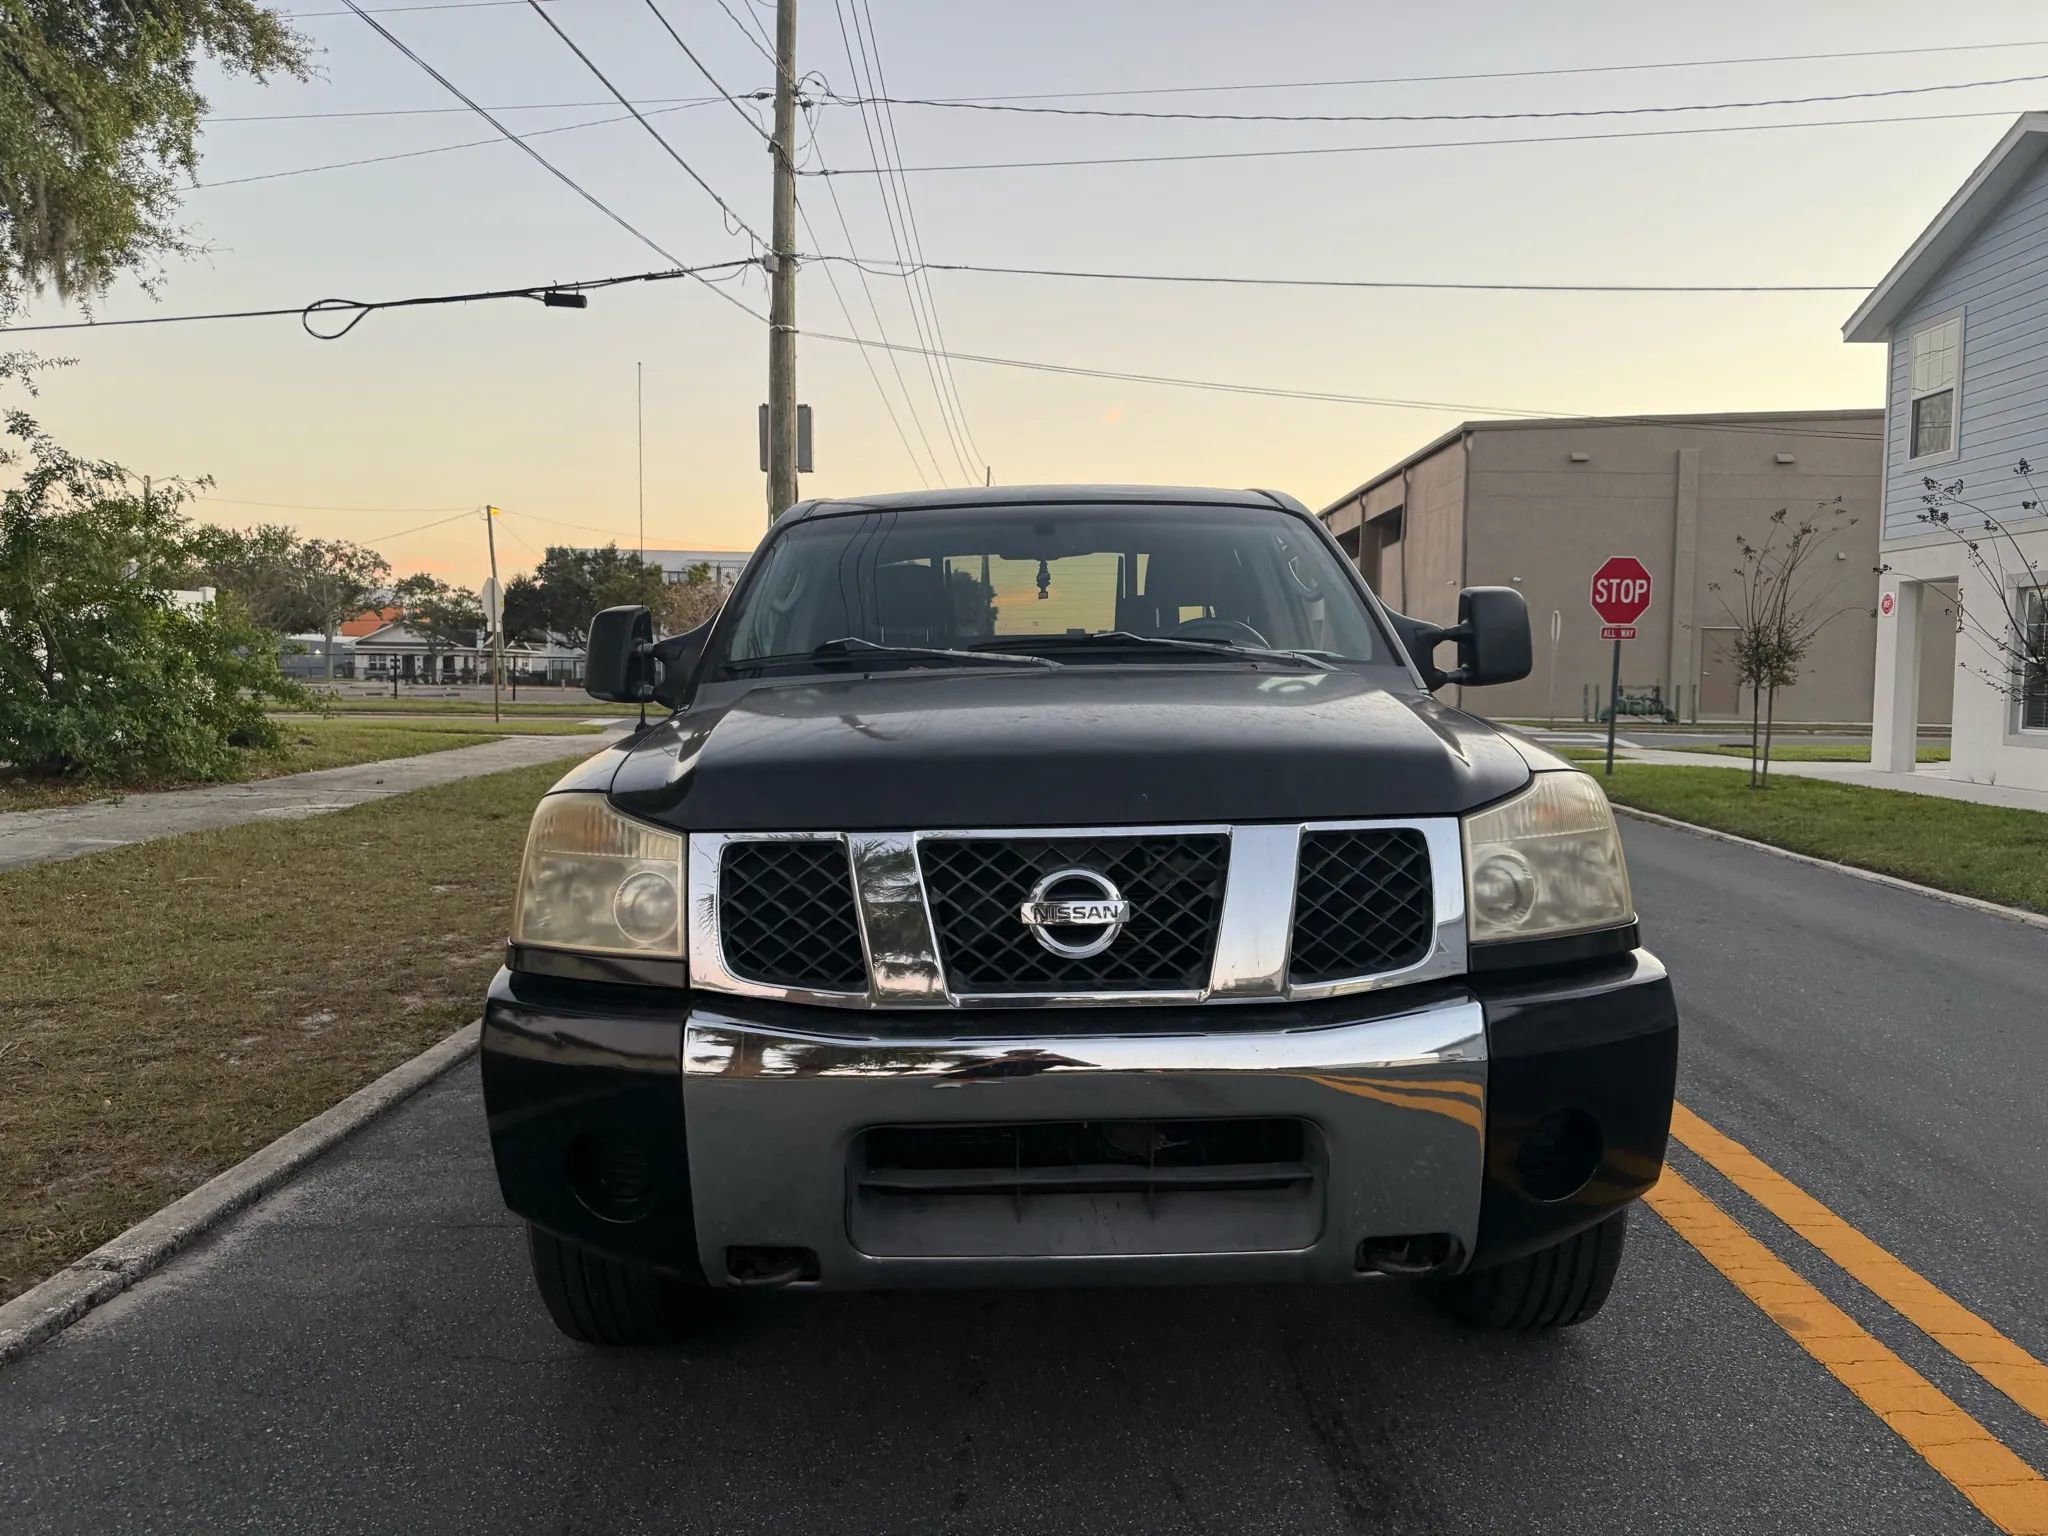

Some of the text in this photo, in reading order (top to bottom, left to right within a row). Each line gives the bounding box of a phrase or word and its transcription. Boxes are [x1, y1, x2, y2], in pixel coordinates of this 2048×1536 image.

[1595, 578, 1648, 604] STOP
[1603, 629, 1635, 637] ALL WAY
[1031, 904, 1119, 921] NISSAN
